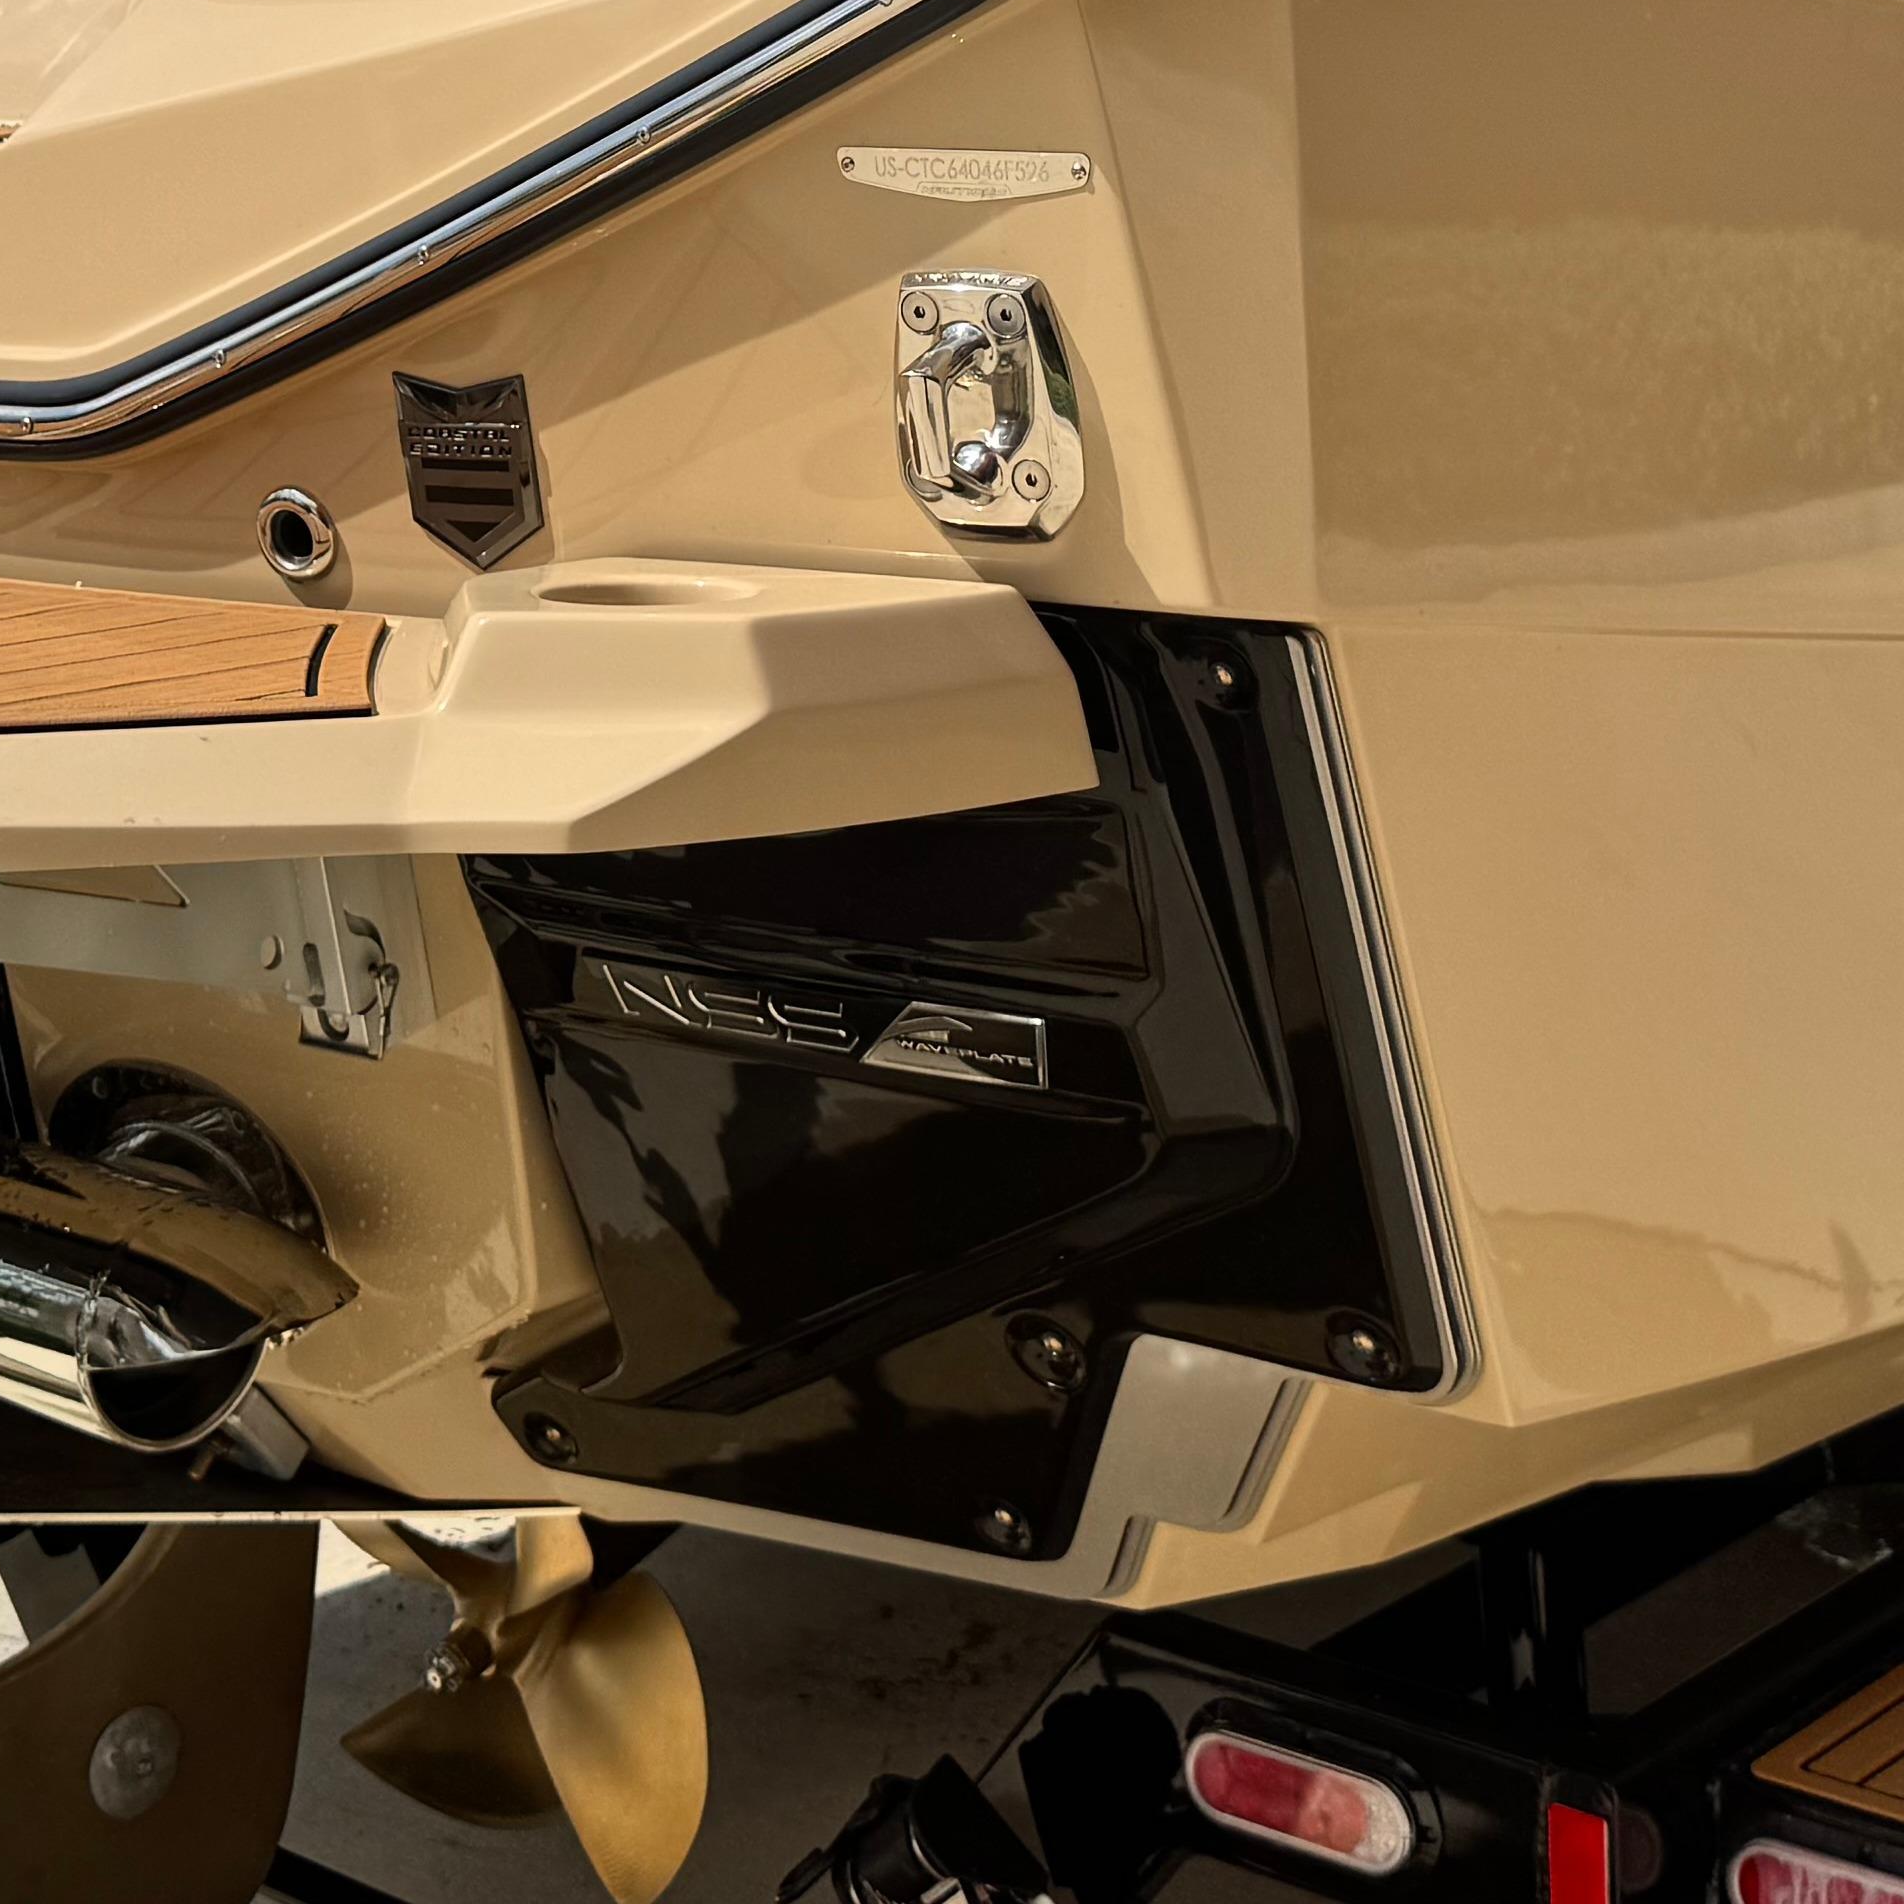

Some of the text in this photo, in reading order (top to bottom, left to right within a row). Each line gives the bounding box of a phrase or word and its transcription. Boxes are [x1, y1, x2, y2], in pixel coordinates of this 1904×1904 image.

[408, 426, 510, 442] COASTAL
[409, 442, 512, 457] EDITION
[897, 1038, 1034, 1068] WAVEPLATE
